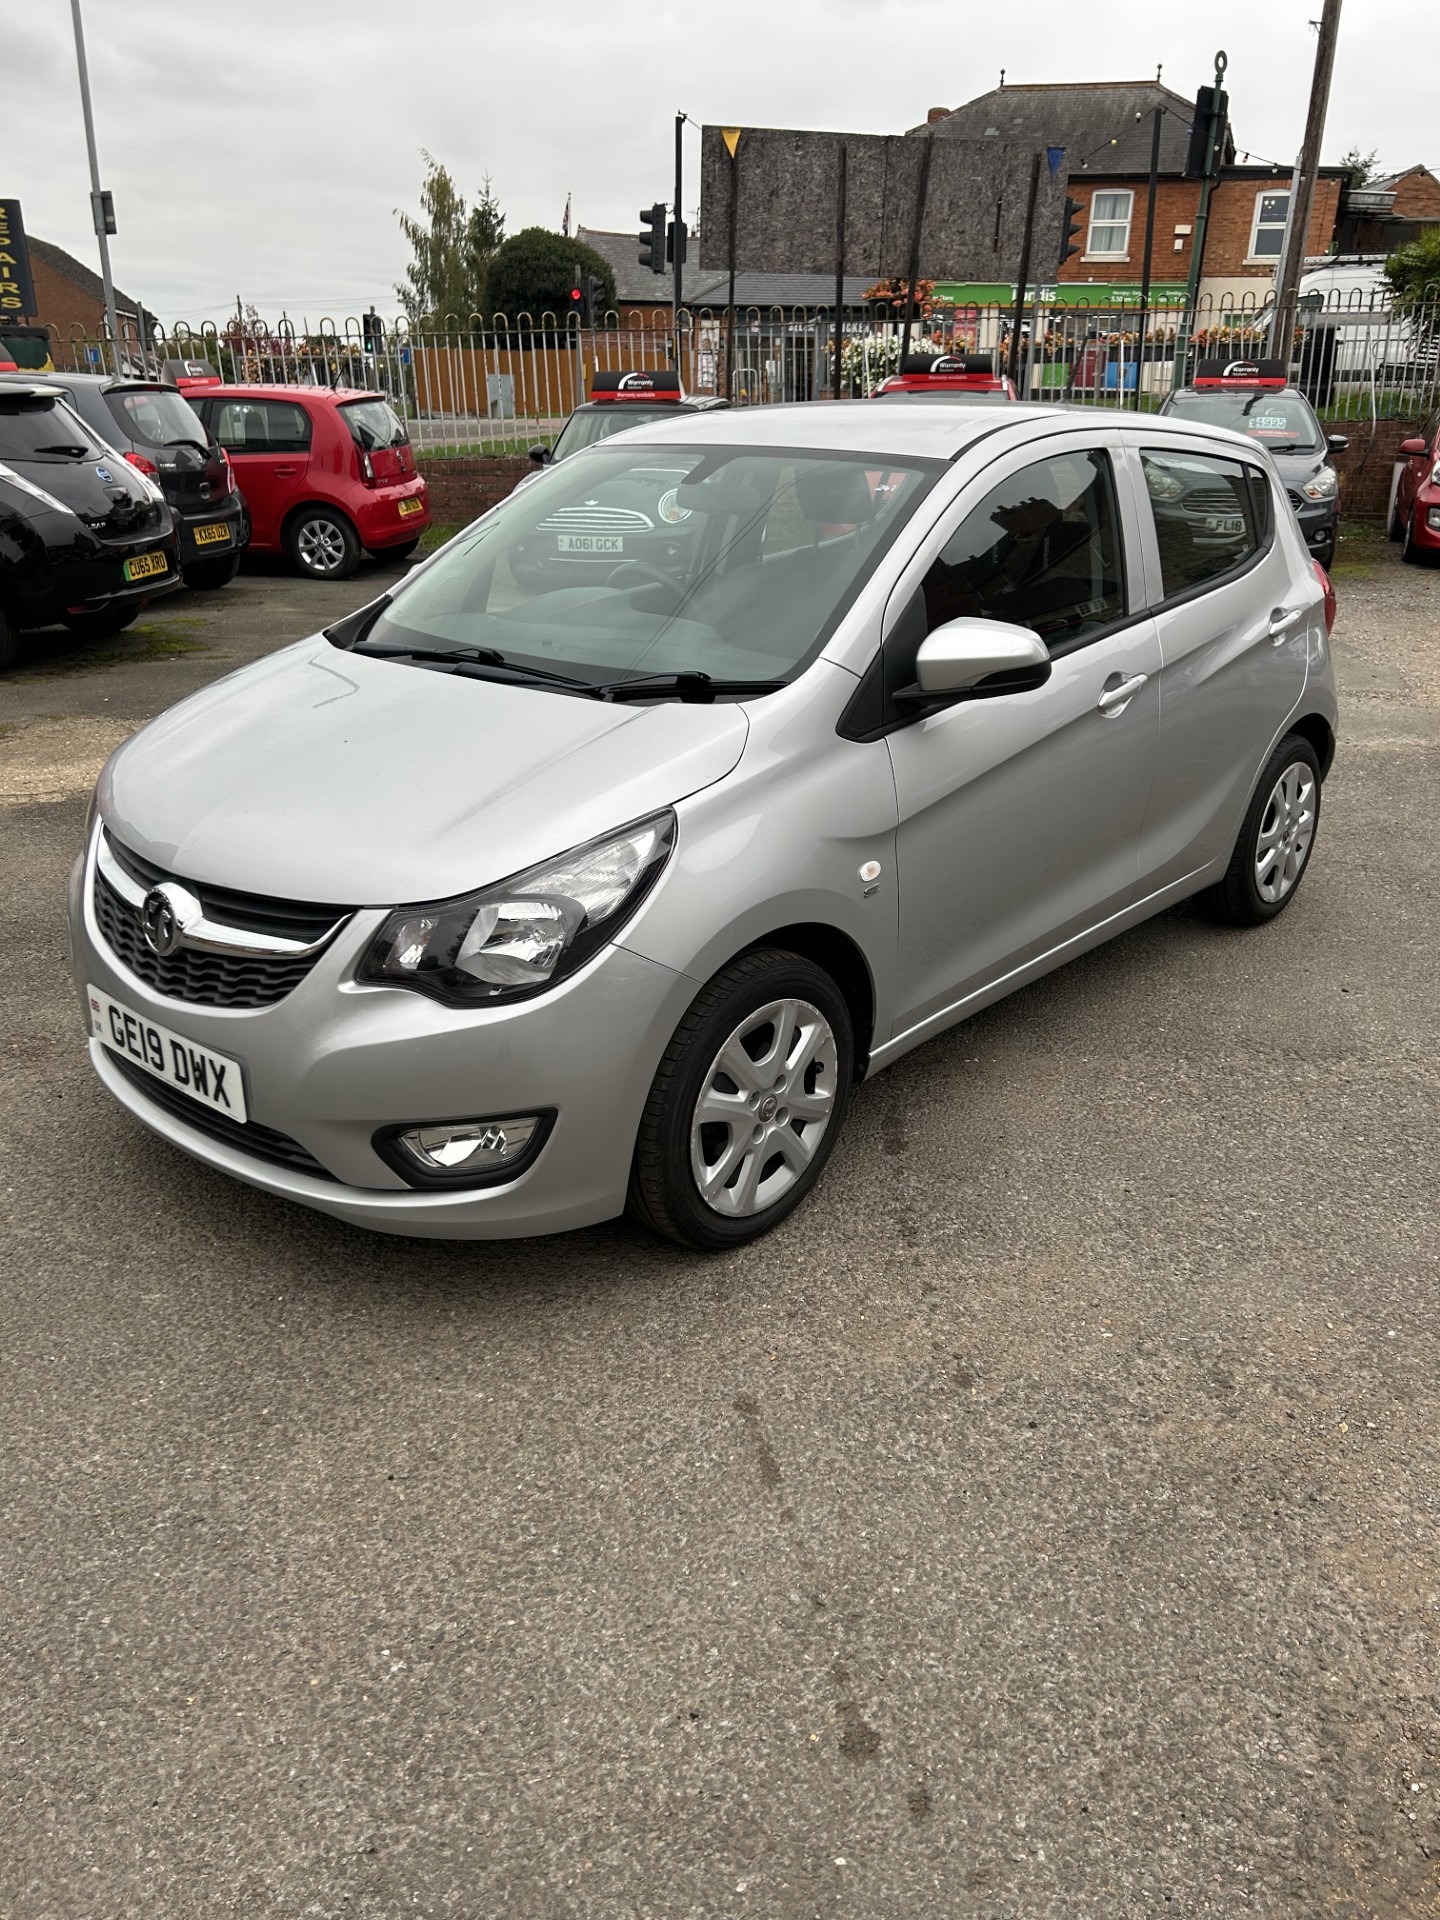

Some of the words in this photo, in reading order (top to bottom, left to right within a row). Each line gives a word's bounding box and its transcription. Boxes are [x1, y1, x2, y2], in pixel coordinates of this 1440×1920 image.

[1248, 417, 1286, 428] £4995
[198, 527, 216, 541] KX65
[216, 525, 229, 539] UZR
[596, 538, 618, 550] GCK
[128, 558, 151, 577] CU65
[108, 1004, 165, 1072] GE19
[169, 1038, 231, 1109] DWX
